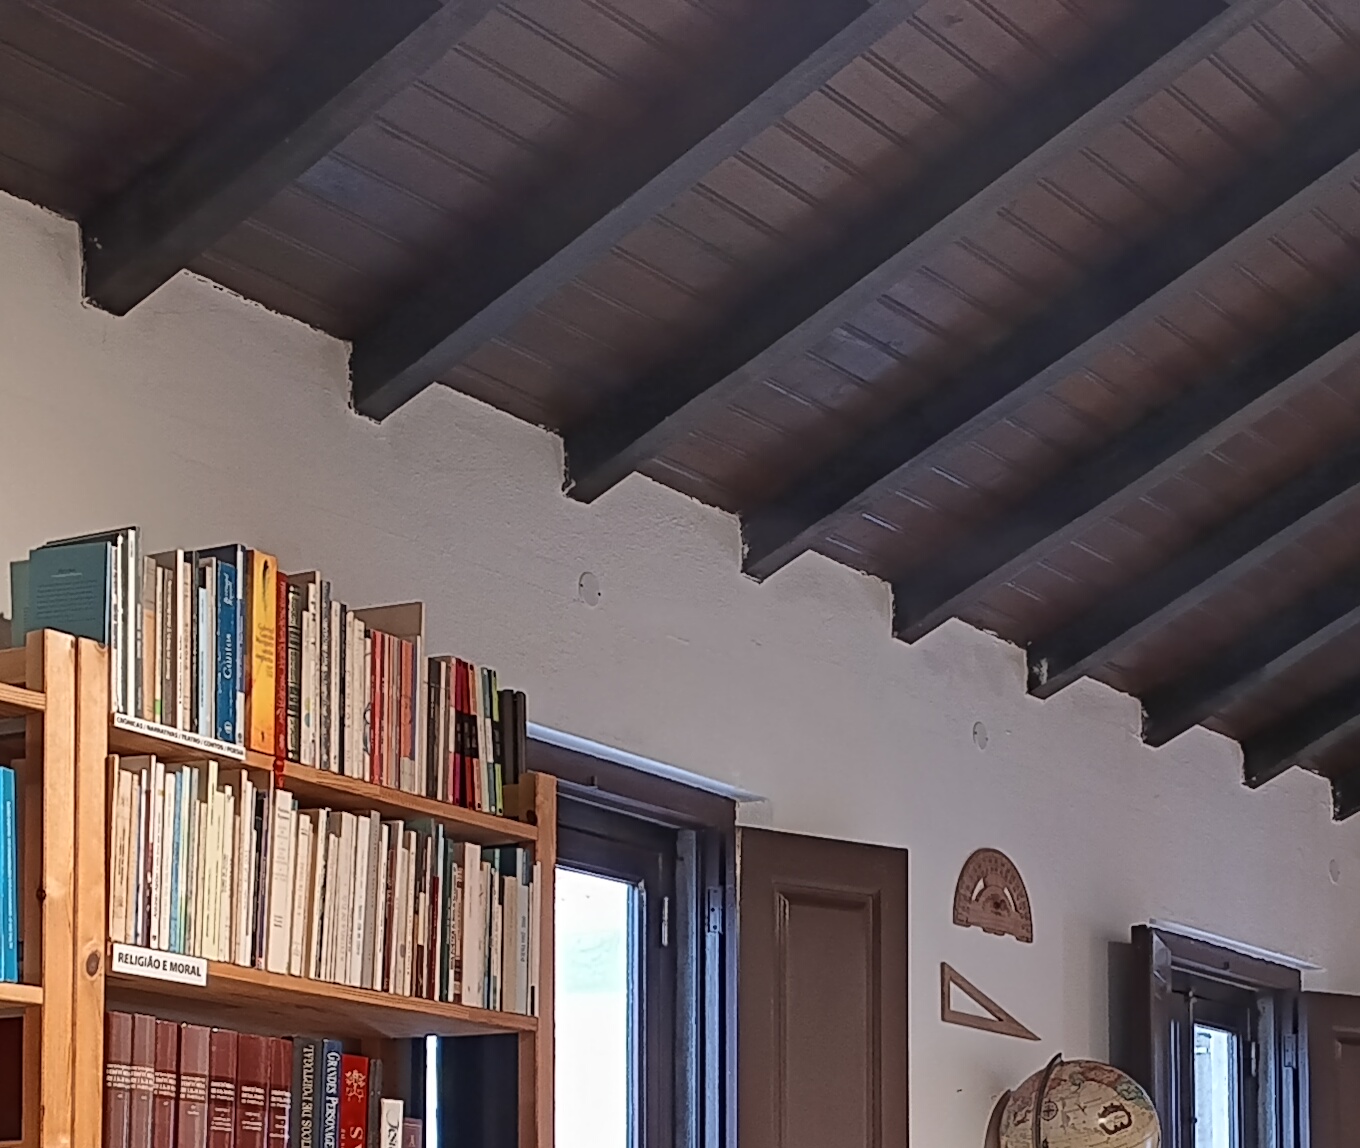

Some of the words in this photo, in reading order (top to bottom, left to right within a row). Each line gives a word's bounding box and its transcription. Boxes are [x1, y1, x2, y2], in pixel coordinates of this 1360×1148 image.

[118, 952, 160, 969] RELIGIÃO
[162, 960, 168, 971] E
[169, 962, 201, 977] MORAL
[302, 1045, 315, 1102] PORTUGAL
[302, 1103, 313, 1118] DE
